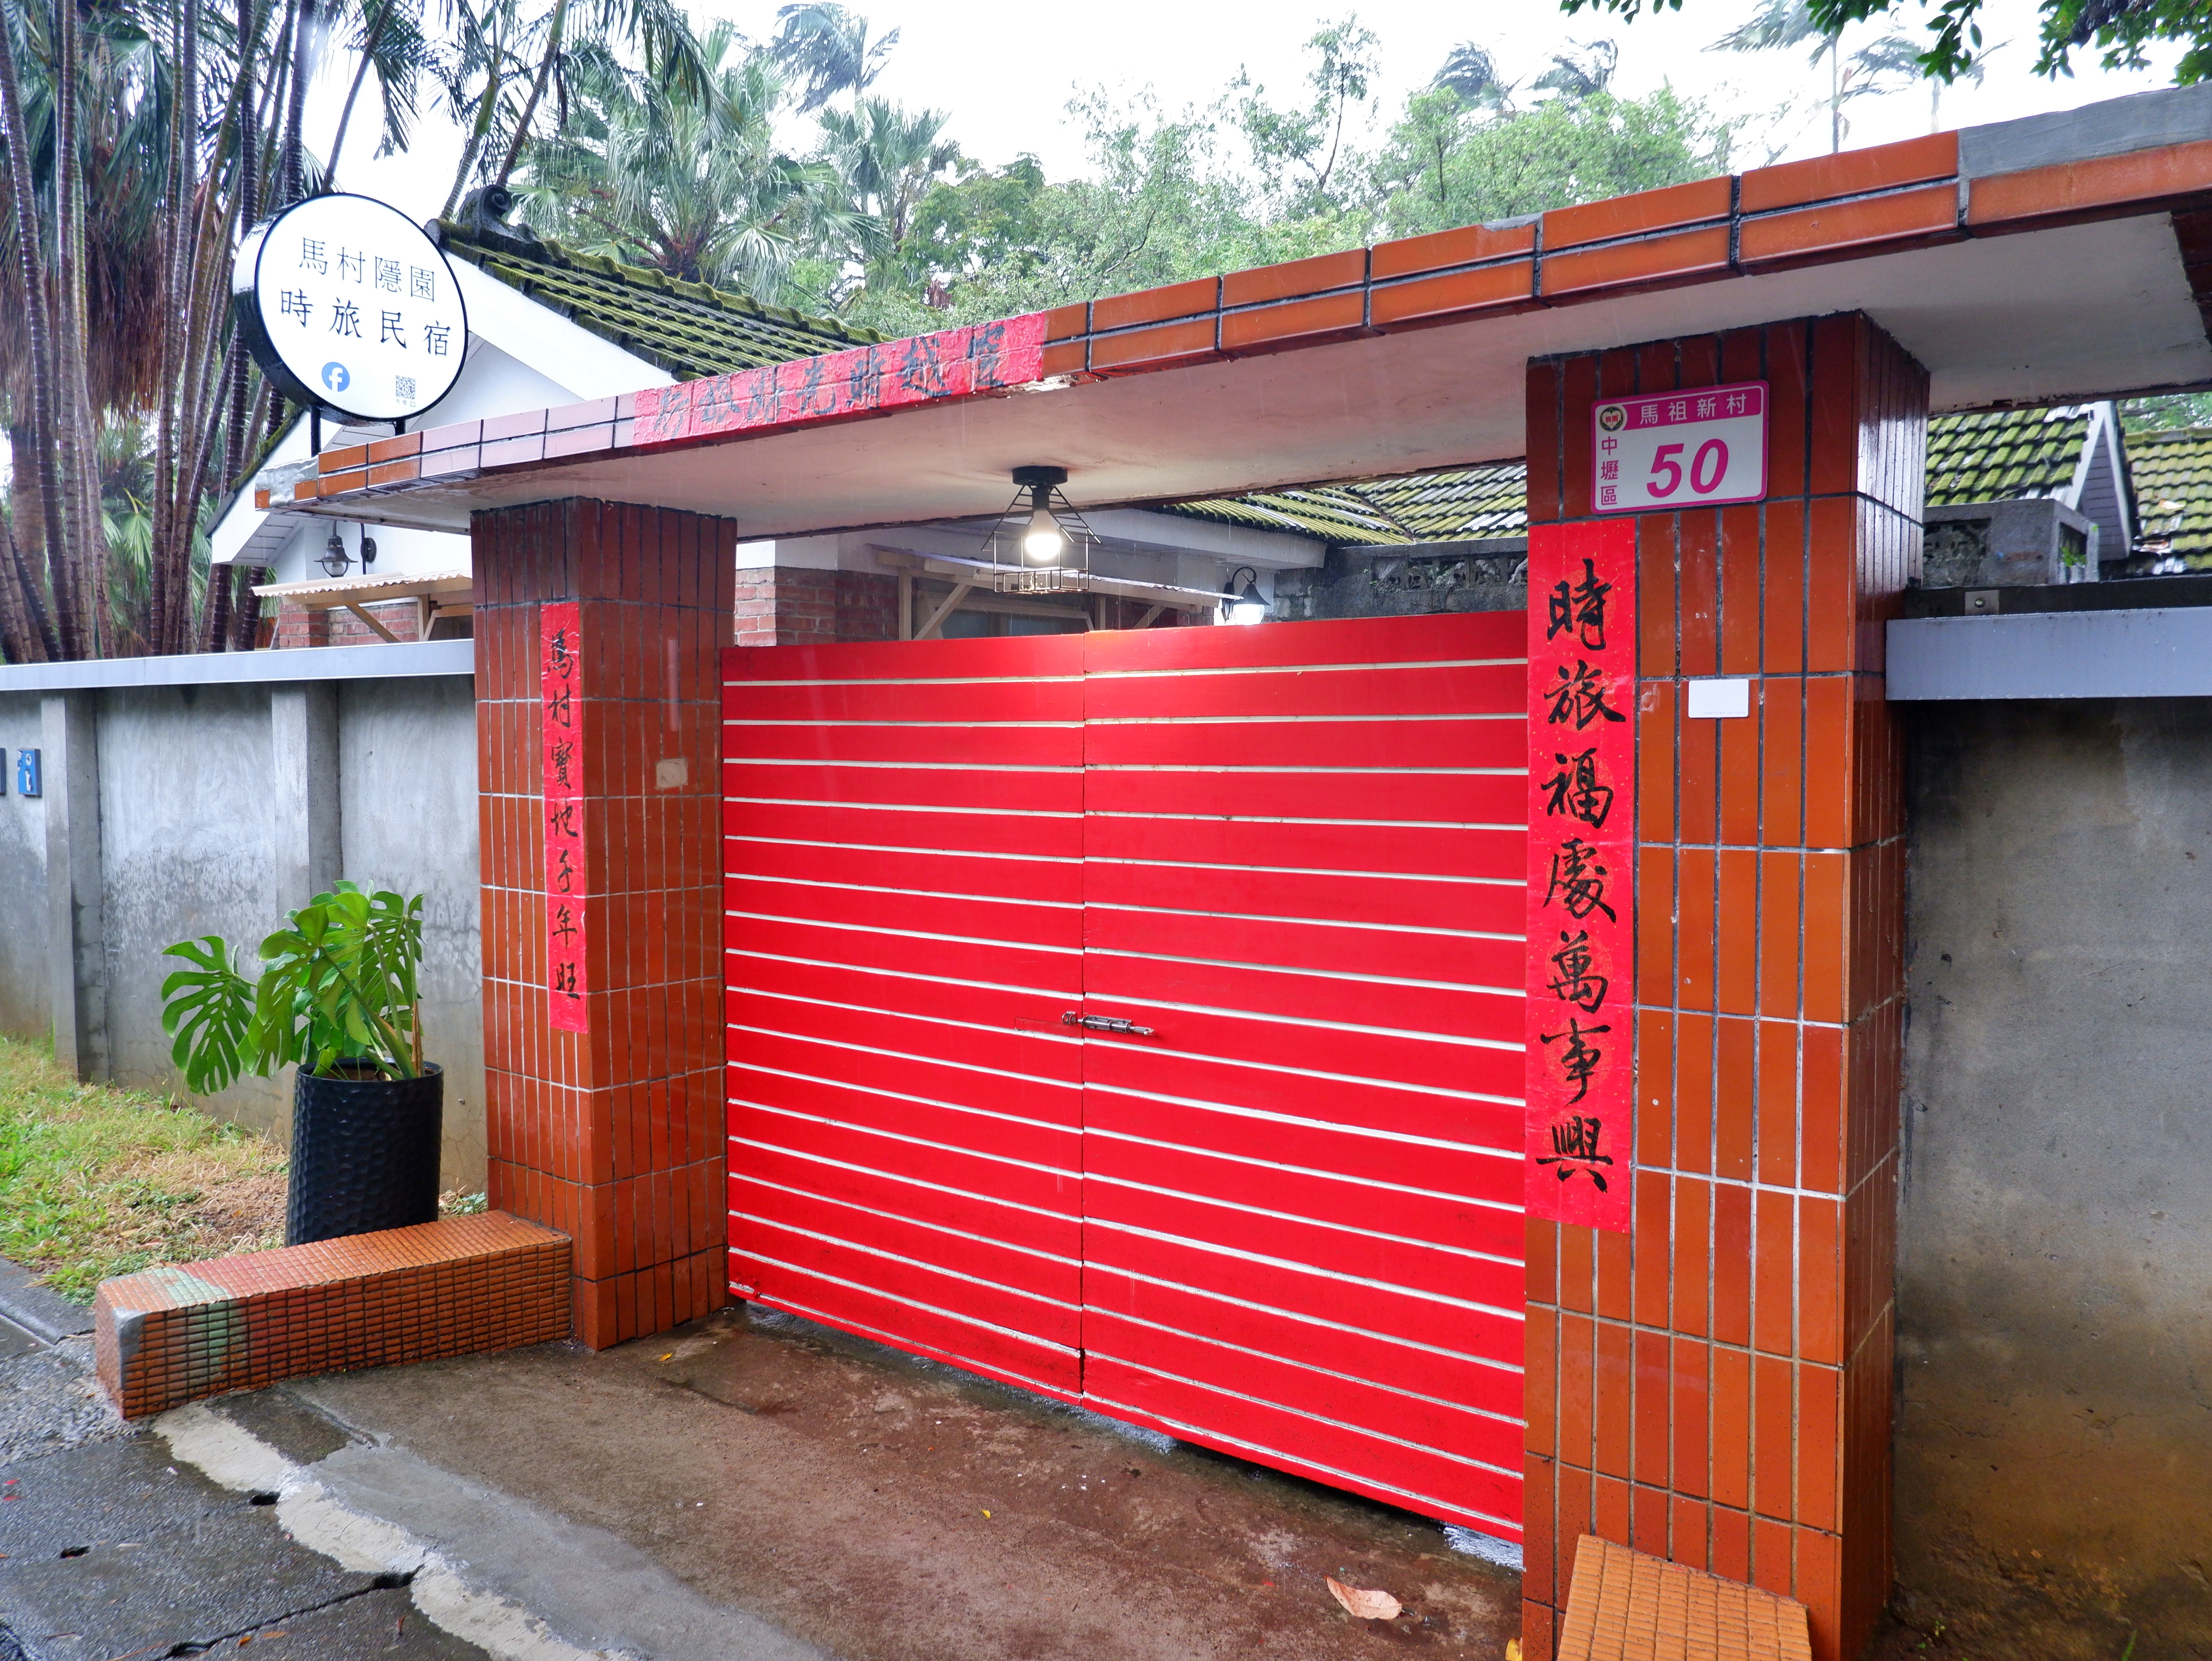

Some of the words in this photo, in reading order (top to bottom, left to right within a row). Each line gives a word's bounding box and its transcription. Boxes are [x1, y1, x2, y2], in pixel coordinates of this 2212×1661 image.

[299, 237, 435, 303] 馬村隱園
[280, 288, 451, 357] 時旅民宿
[1640, 393, 1747, 425] 馬祖新村
[1600, 436, 1619, 505] 中壢區
[1646, 438, 1729, 498] 50
